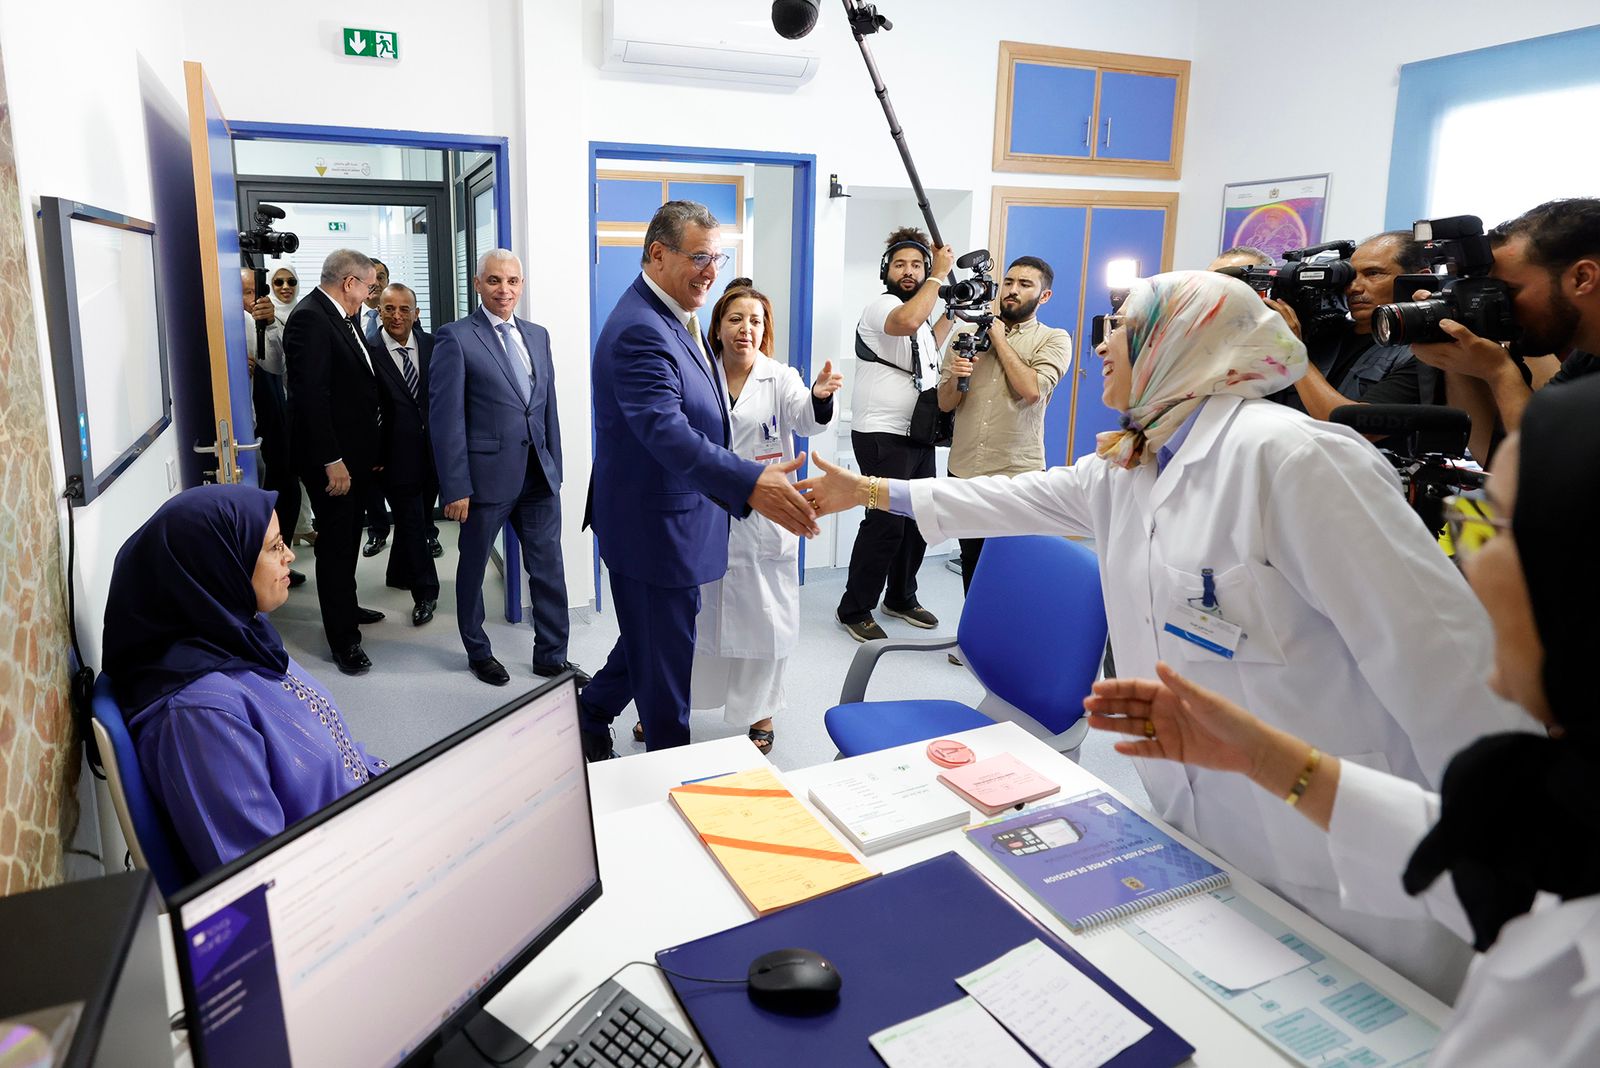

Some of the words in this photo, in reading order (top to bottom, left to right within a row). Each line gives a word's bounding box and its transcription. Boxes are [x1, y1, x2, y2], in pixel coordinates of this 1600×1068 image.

[1143, 844, 1164, 853] OUTIL
[1121, 849, 1145, 861] D'AIDE
[1105, 857, 1118, 865] LA
[1076, 866, 1089, 874] DE
[1086, 861, 1108, 871] PRISE
